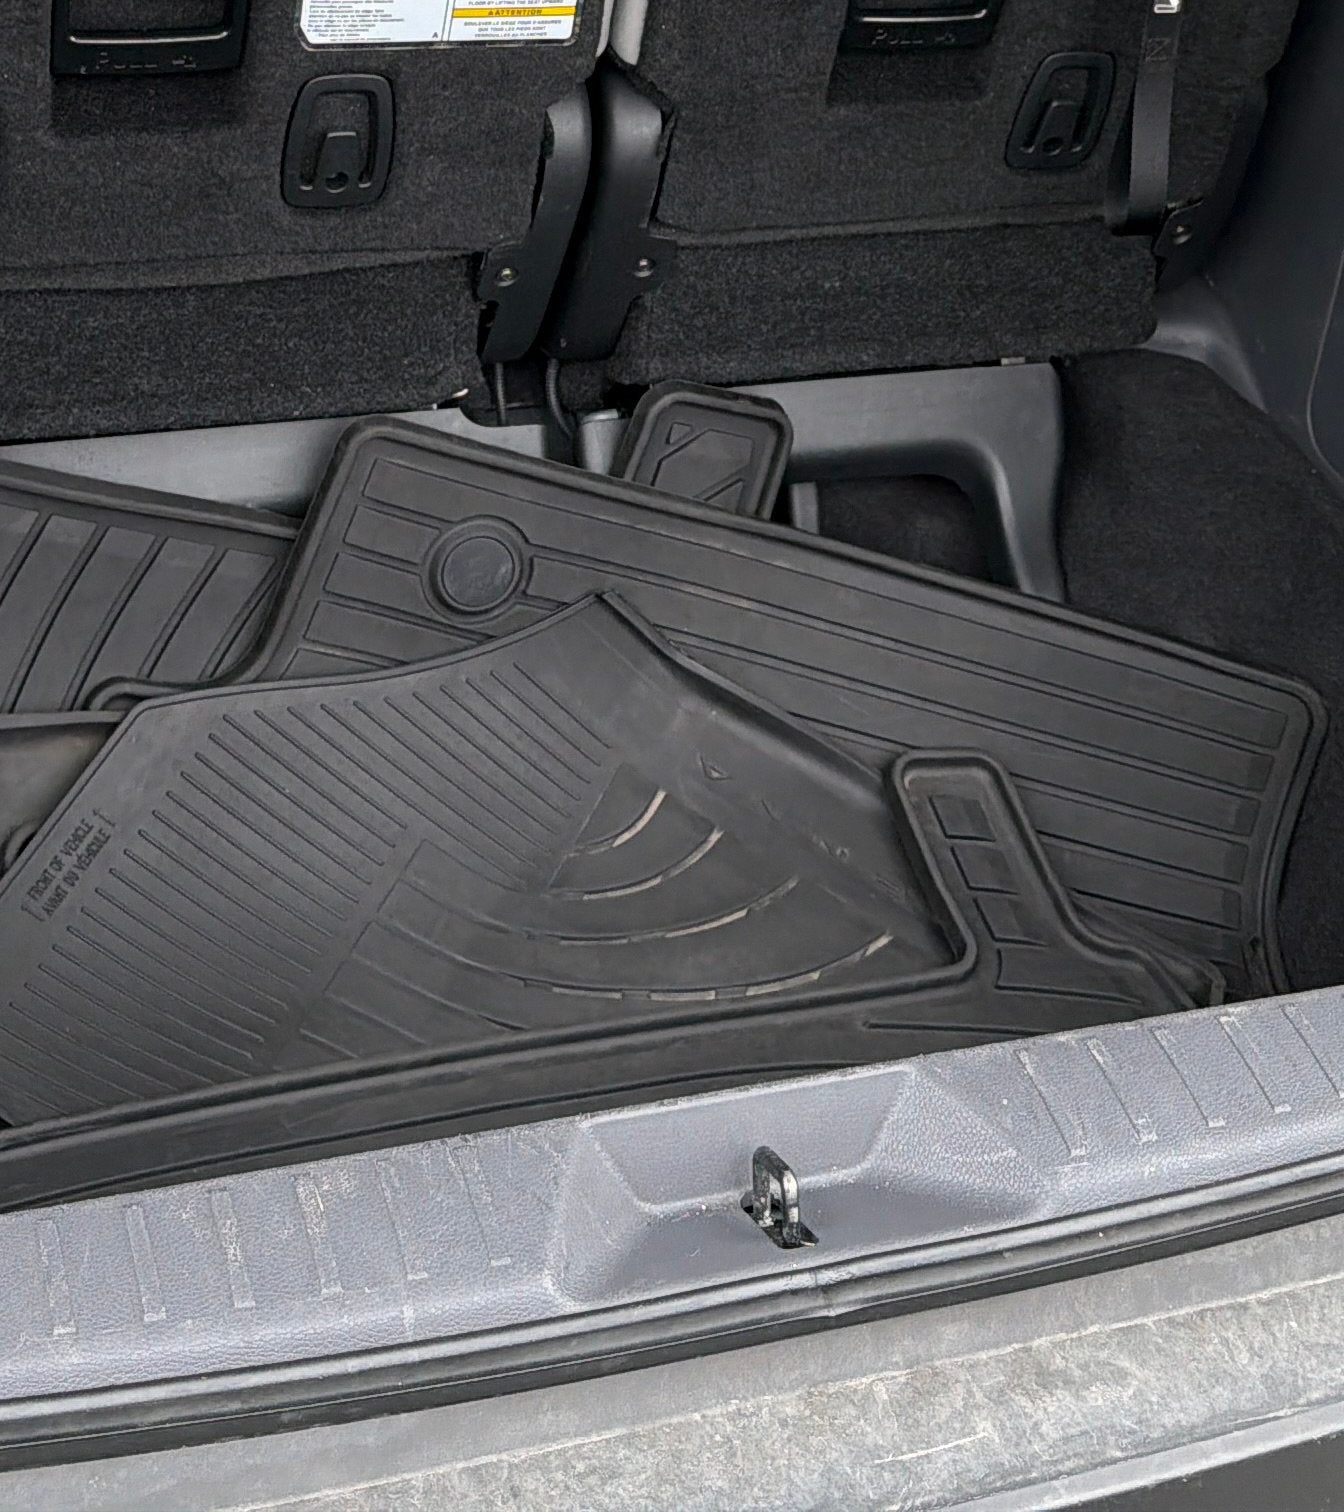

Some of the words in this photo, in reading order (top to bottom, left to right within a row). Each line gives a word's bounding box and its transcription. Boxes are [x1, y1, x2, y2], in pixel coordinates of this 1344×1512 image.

[27, 868, 56, 901] FRONT
[49, 855, 66, 872] OF
[60, 818, 94, 857] VEHICLE
[42, 884, 69, 917] AVANT
[62, 870, 80, 887] DU
